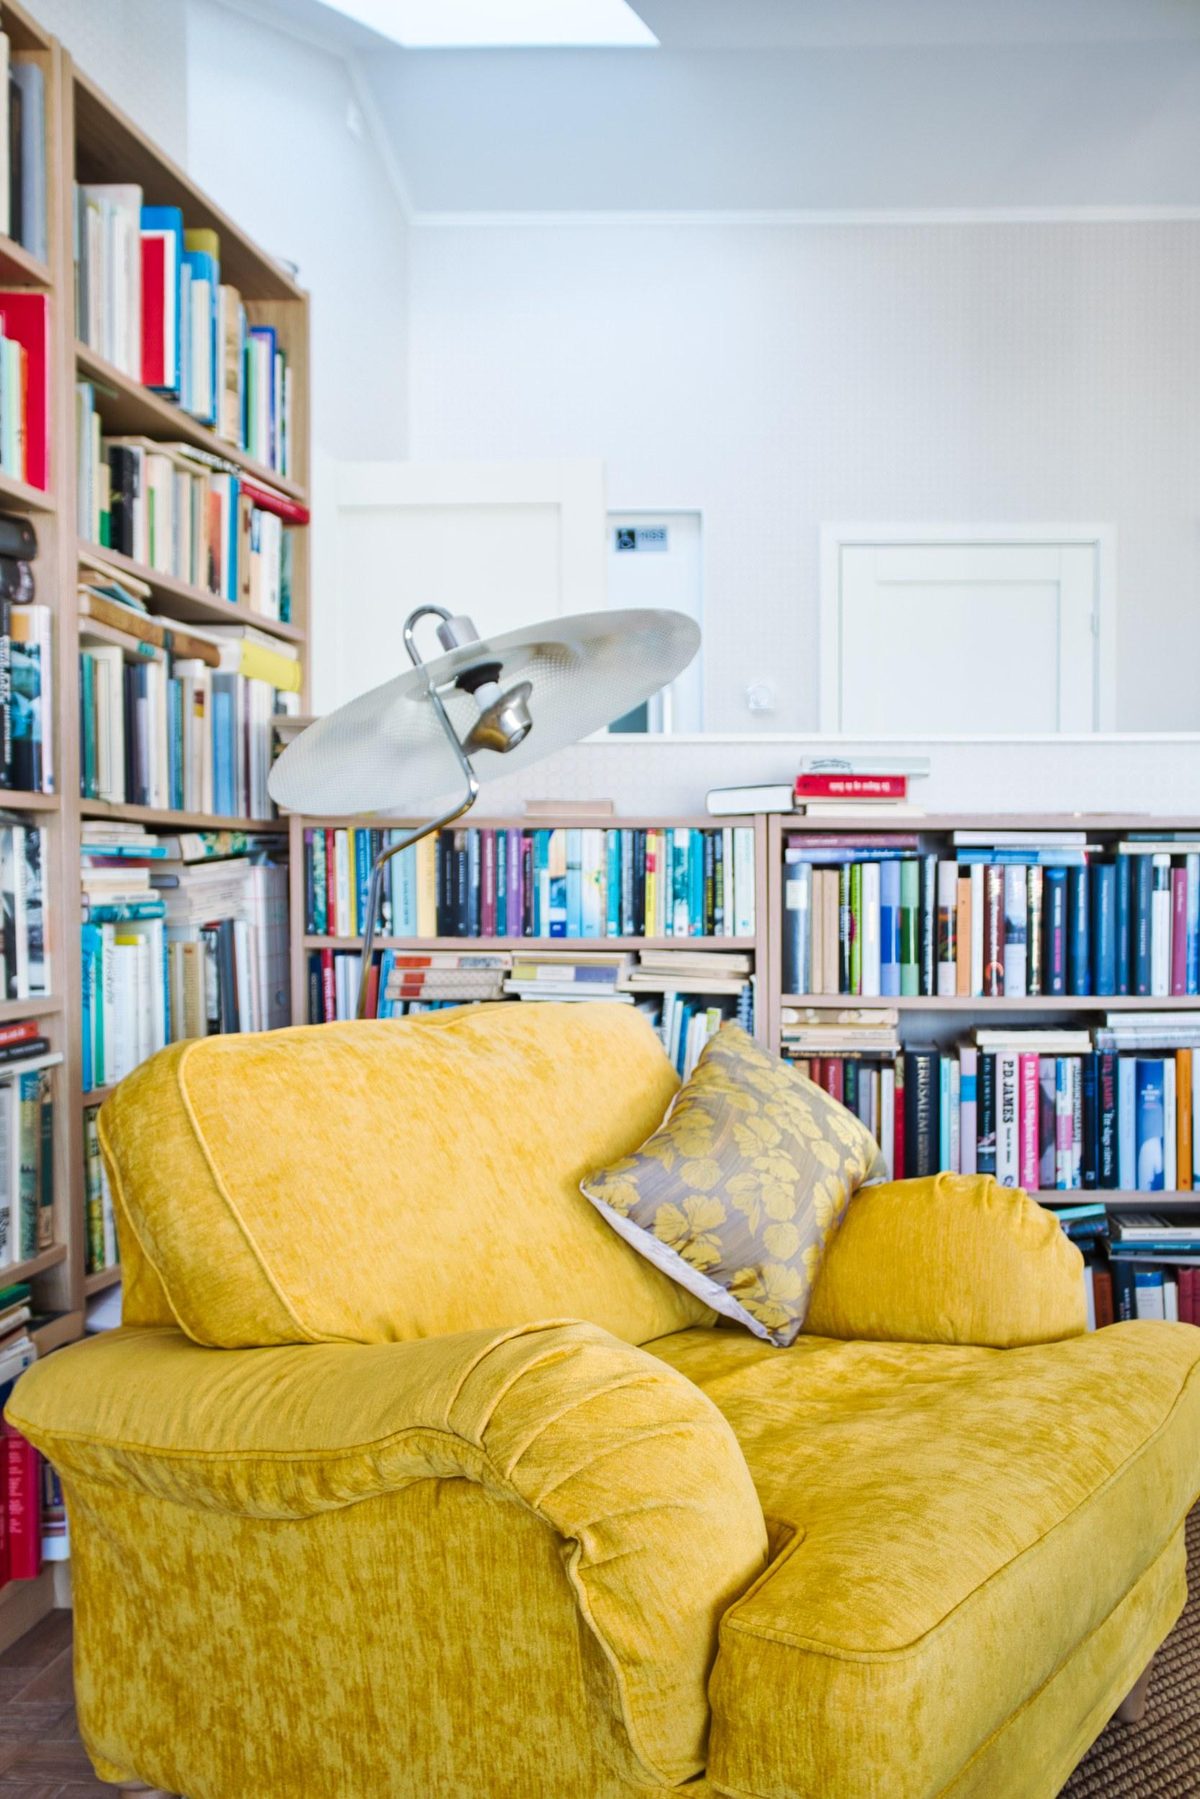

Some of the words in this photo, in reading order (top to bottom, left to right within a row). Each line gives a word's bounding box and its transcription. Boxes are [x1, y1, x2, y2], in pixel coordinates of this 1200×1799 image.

[1002, 1060, 1014, 1081] P.D.
[915, 1055, 930, 1133] JERUSALEM
[1002, 1084, 1014, 1124] JAMES
[1025, 1079, 1036, 1109] JAMES
